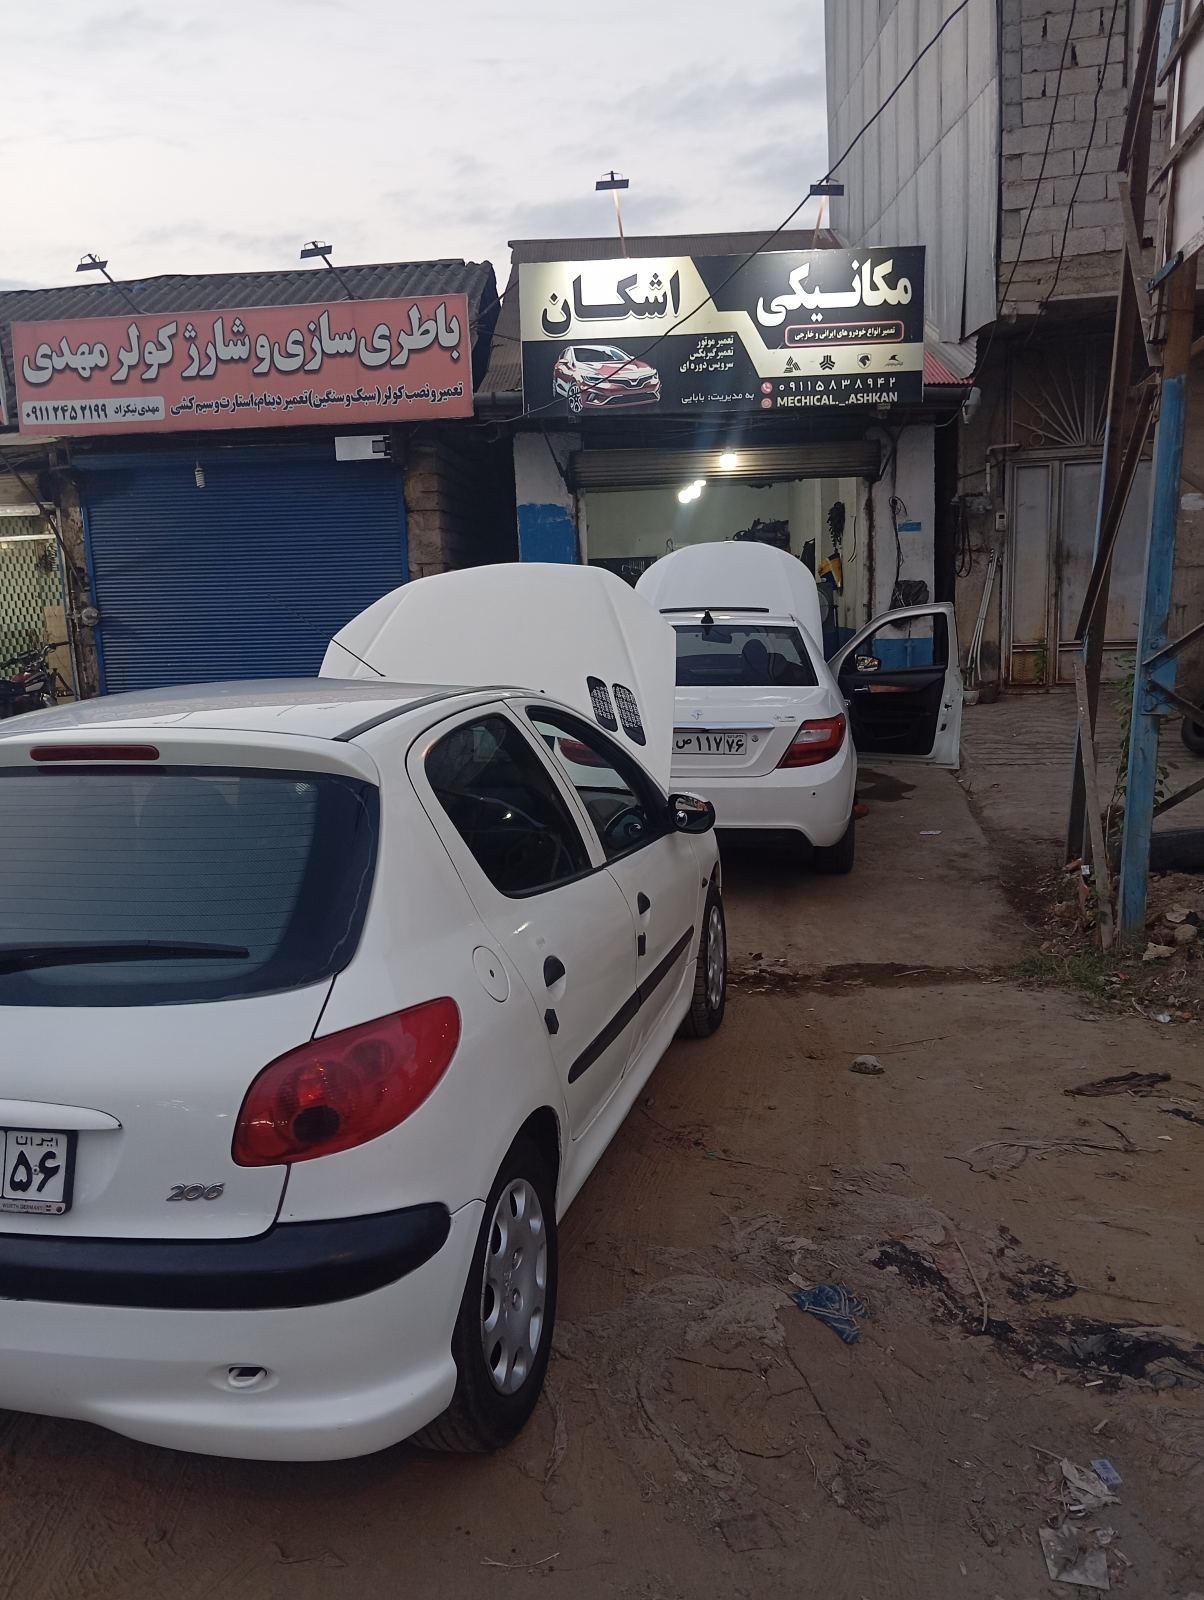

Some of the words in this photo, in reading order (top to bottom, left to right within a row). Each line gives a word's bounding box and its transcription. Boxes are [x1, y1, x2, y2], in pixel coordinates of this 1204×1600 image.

[757, 258, 912, 326] مکانیکی
[541, 270, 681, 337] اشکان
[358, 302, 461, 367] باطری
[794, 330, 814, 341] خارجی
[819, 329, 836, 340] ایرانی
[836, 329, 848, 338] های
[849, 327, 866, 338] خودرو
[867, 326, 881, 337] انواع
[882, 326, 896, 336] تعمیر
[181, 316, 250, 377] شارژ
[273, 309, 357, 372] سازی
[696, 336, 715, 348] موتور
[717, 335, 734, 346] تعمیر
[111, 320, 177, 382] کولر
[252, 333, 272, 374] و
[716, 347, 734, 359] تعمیر
[22, 335, 109, 385] مهدی
[679, 360, 690, 372] ای
[690, 361, 707, 372] دوره
[708, 361, 734, 371] سرویس
[383, 385, 405, 405] کولر
[405, 383, 431, 403] نصب
[430, 387, 438, 403] و
[437, 382, 464, 402] تعمیر
[681, 392, 705, 404] بابایی
[707, 392, 743, 402] مدیریت:
[744, 392, 755, 401] به
[170, 395, 196, 415] کشی
[195, 399, 214, 415] سیم
[213, 400, 220, 414] و
[220, 393, 255, 412] استارت
[282, 390, 308, 411] تعمیر
[344, 394, 352, 407] و
[113, 403, 138, 418] نیکزاد
[137, 405, 160, 418] مهدی
[15, 1135, 59, 1147] ایران
[9, 1150, 61, 1193] ۵۶
[165, 1182, 225, 1202] 206
